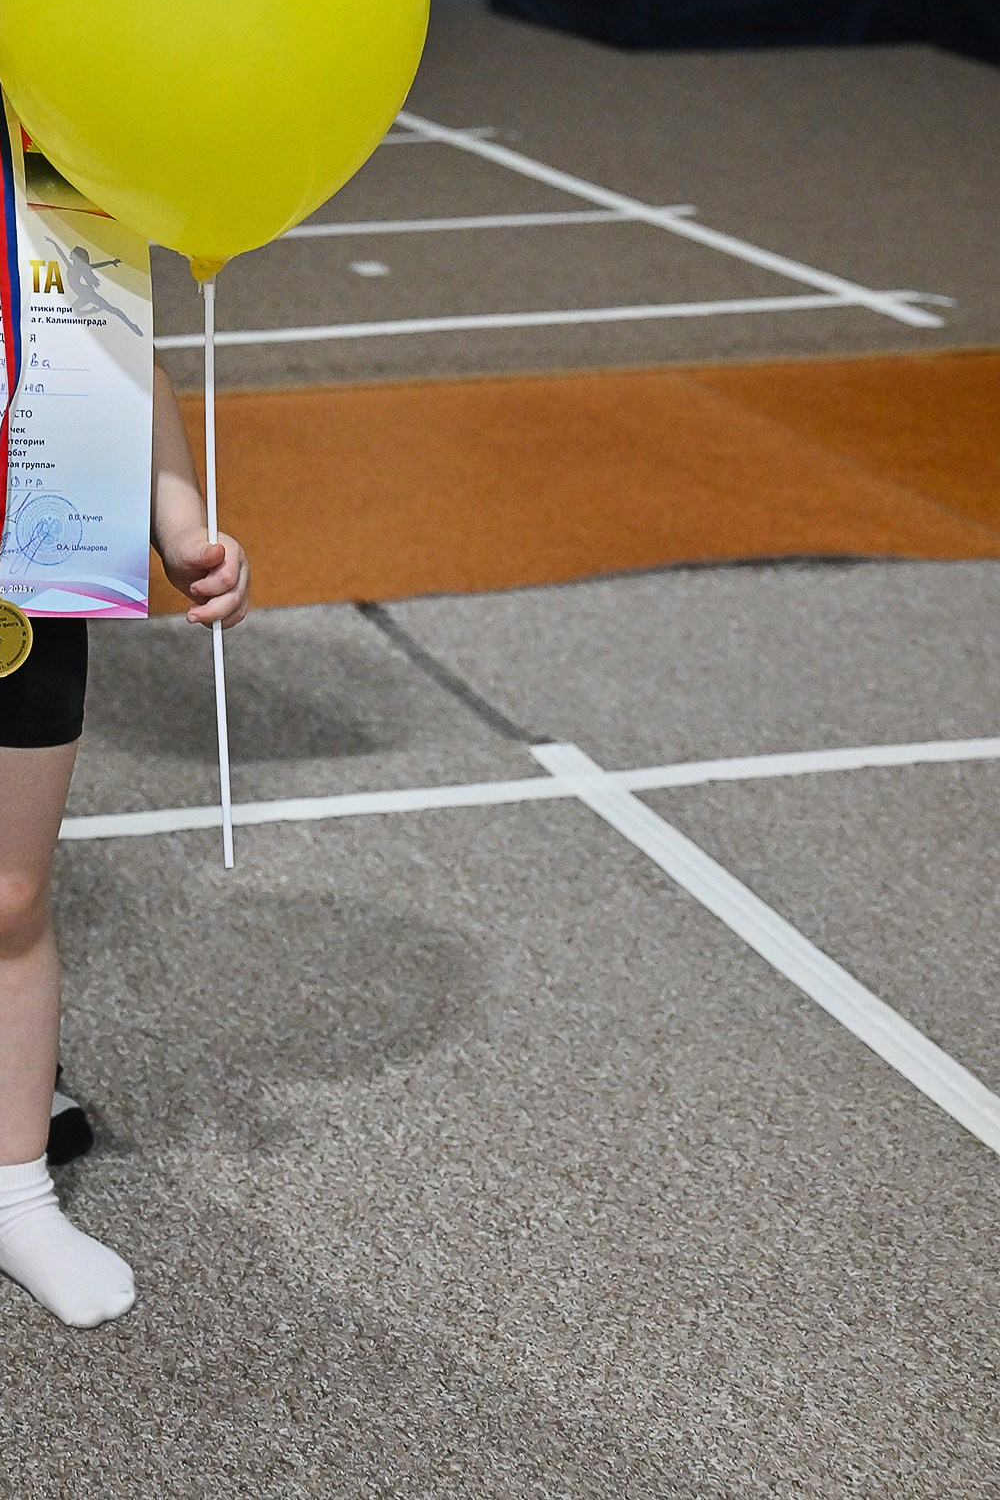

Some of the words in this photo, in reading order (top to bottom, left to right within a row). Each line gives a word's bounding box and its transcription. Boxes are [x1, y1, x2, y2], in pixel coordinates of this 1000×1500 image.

[56, 306, 73, 314] при
[46, 316, 107, 326] Калининграда
[21, 462, 56, 470] группа»
[82, 514, 103, 522] Кучер
[71, 543, 108, 553] Шикарова
[9, 584, 28, 593] 2025
